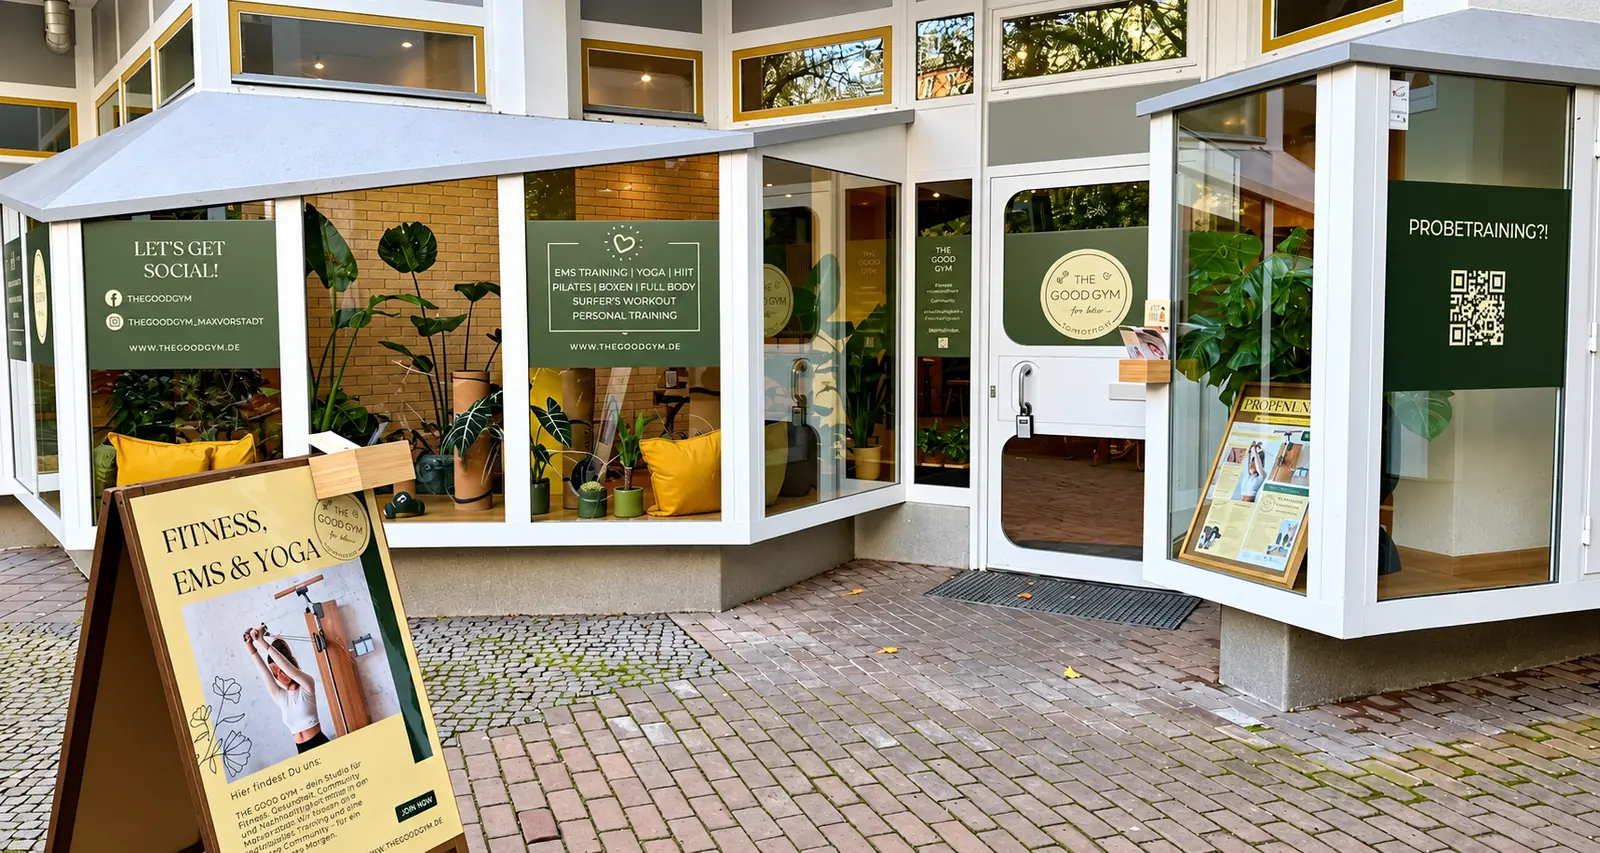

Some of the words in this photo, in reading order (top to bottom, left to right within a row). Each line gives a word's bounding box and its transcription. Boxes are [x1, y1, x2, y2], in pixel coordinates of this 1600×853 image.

[1408, 218, 1549, 240] PROBETRAINING?!
[134, 240, 185, 257] LET'S
[188, 240, 226, 256] GET
[935, 246, 952, 254] THE
[931, 255, 956, 264] GOOD
[144, 263, 219, 279] SOCIAL!
[554, 268, 577, 277] EMS
[579, 268, 628, 277] TRAINING
[636, 268, 666, 277] YOGA
[674, 268, 695, 277] HIIT
[934, 265, 953, 273] GYM
[1074, 274, 1096, 285] THE
[552, 283, 592, 292] PILATES
[599, 283, 633, 292] BOXEN
[640, 283, 666, 291] FULL
[667, 283, 697, 291] BODY
[127, 294, 192, 303] THEGOODGYM
[1050, 290, 1090, 301] GOOD
[1091, 289, 1121, 300] GYM
[572, 297, 621, 306] SURFER'S
[623, 297, 677, 306] WORKOUT
[572, 311, 627, 320] PERSONAL
[629, 311, 678, 320] TRAINING
[128, 317, 264, 327] THEGOODGYM_MAXVORSTADT
[128, 343, 240, 352] WWW.THEGOODGYM.DE
[569, 343, 681, 351] WWW.THEGOODGYM.DE
[334, 506, 349, 518] THE
[317, 513, 344, 529] GOOD
[345, 522, 363, 535] GYM
[161, 510, 268, 554] FITNESS,
[172, 561, 226, 596] EMS
[230, 555, 251, 581] &
[253, 538, 322, 573] YOGA
[230, 787, 251, 801] Hier
[252, 772, 287, 792] findest
[287, 767, 301, 778] Du
[303, 757, 322, 771] uns:
[235, 807, 253, 820] THE
[254, 796, 279, 811] GOOD
[280, 788, 298, 801] GYM
[305, 778, 324, 790] dein
[324, 767, 349, 782] Studio
[350, 761, 362, 771] für
[401, 803, 417, 817] JOIN
[416, 796, 433, 809] NOW
[330, 808, 345, 820] und
[335, 816, 347, 827] für
[349, 811, 361, 821] ein
[241, 826, 258, 839] und
[305, 832, 338, 850] Morgen.
